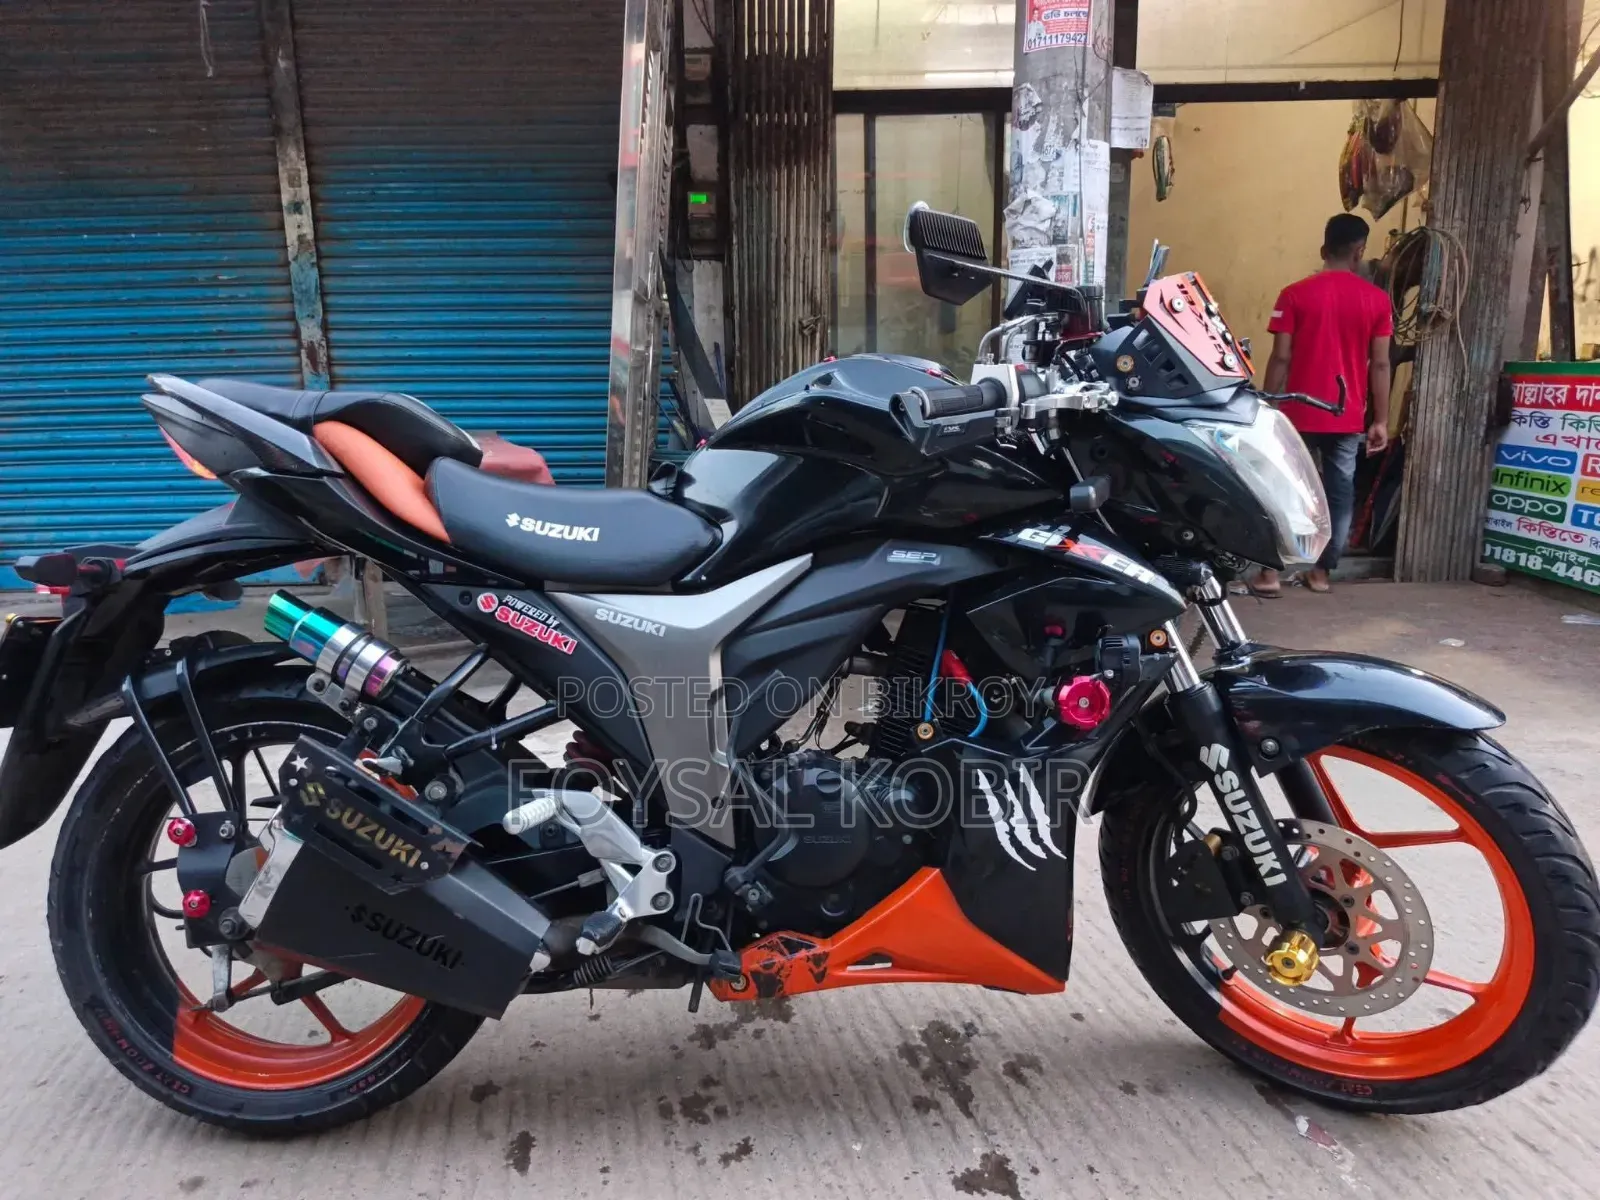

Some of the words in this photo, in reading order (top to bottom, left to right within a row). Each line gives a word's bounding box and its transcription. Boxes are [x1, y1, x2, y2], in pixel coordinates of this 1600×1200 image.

[1501, 450, 1571, 467] vivo
[520, 517, 600, 542] SUZUKI
[502, 595, 548, 622] POWERED
[595, 608, 667, 637] SUZUKI
[495, 606, 579, 655] SUZUKI
[325, 799, 422, 868] SUZUKI
[1214, 770, 1288, 887] SUZUKI
[364, 911, 464, 970] SUZUKI
